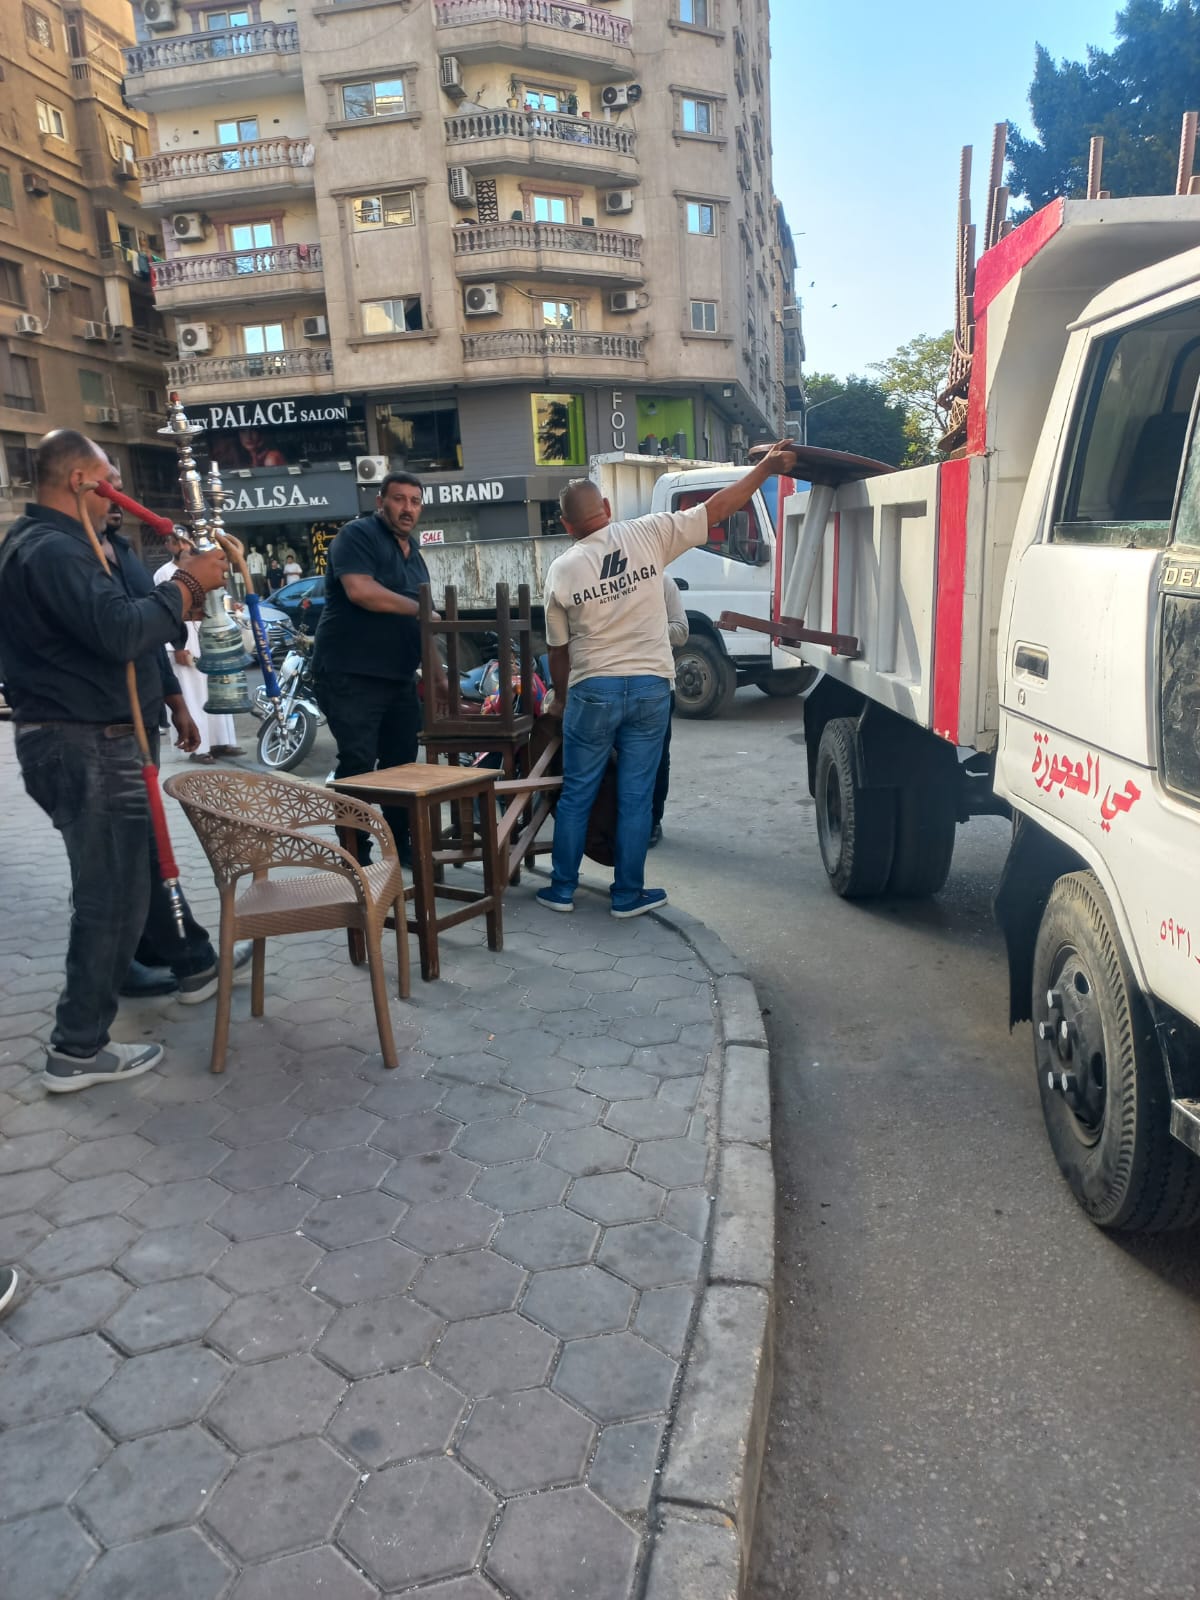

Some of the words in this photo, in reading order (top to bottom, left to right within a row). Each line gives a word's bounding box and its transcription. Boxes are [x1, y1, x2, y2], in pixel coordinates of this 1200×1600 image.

[209, 401, 298, 429] PALACE
[300, 407, 346, 422] SALON
[222, 485, 308, 511] SALSA
[439, 481, 504, 504] BRAND
[422, 531, 442, 543] SALE
[573, 564, 657, 606] BALENCIAGA
[600, 593, 620, 605] ACTIVE
[1031, 731, 1100, 800] العجوزة
[1100, 779, 1142, 833] حي
